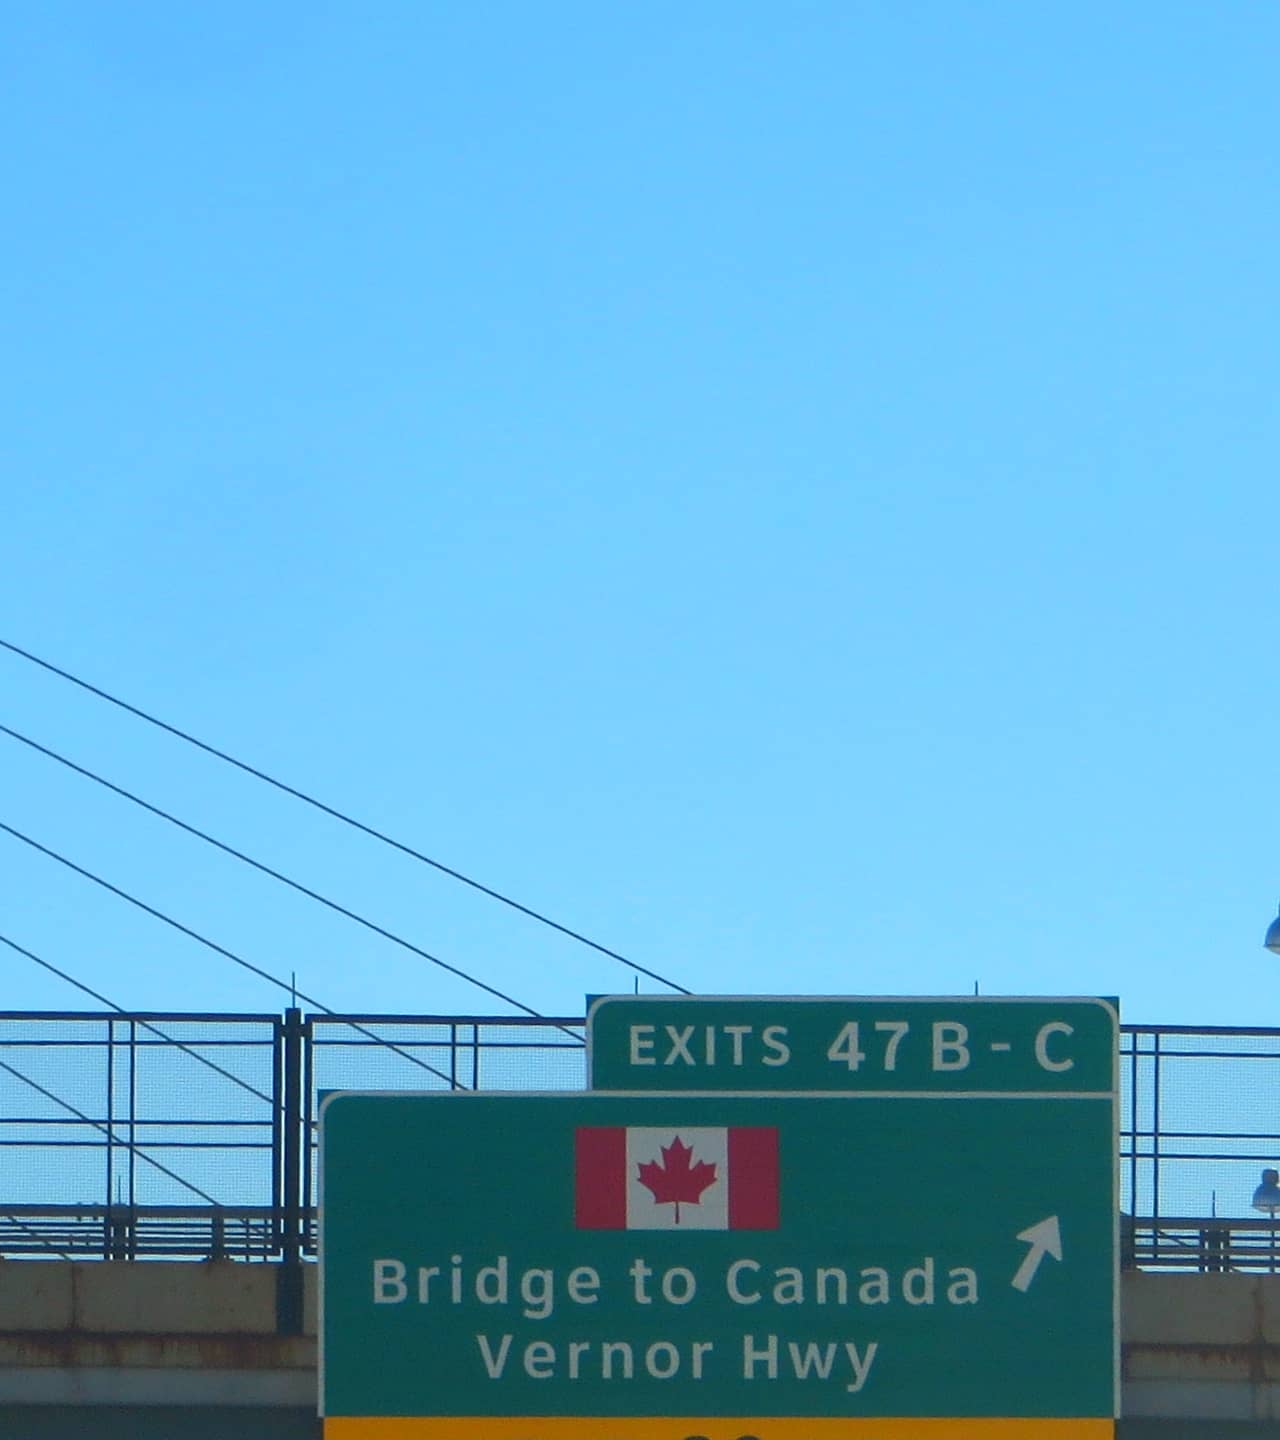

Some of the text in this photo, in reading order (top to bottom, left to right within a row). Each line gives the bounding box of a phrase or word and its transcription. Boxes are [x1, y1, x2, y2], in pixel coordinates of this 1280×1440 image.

[629, 1024, 791, 1067] EXITS
[826, 1021, 910, 1071] 47
[372, 1254, 979, 1320] Bridge to Canada
[476, 1334, 879, 1393] Vernor Hwy
